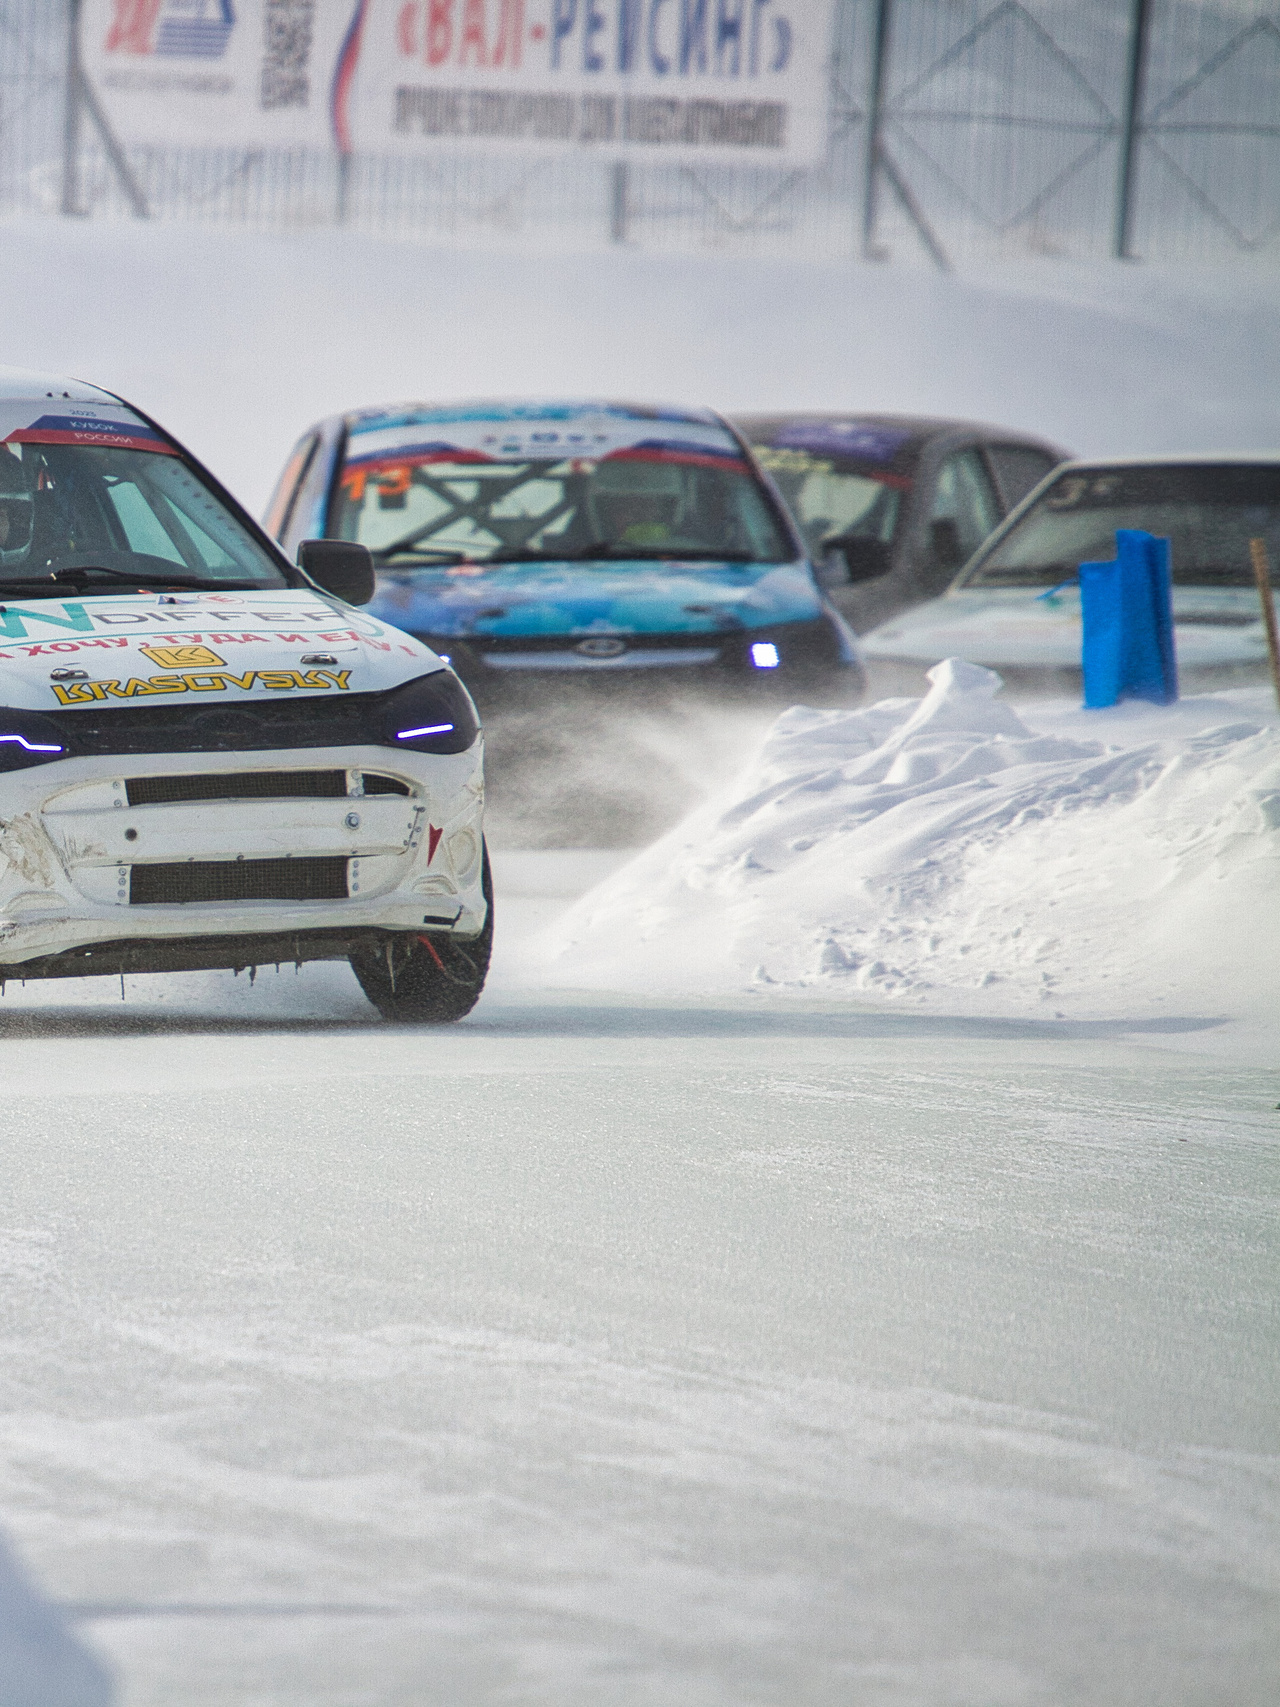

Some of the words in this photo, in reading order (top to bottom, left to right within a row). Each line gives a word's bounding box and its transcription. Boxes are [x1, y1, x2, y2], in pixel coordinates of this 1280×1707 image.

[71, 409, 97, 417] 2023
[70, 421, 119, 431] КУБОК
[74, 432, 133, 445] РОССИИ
[341, 466, 411, 501] 13
[153, 633, 271, 645] ТУДА
[274, 632, 310, 644] И
[49, 669, 353, 706] KRASOVSKY
